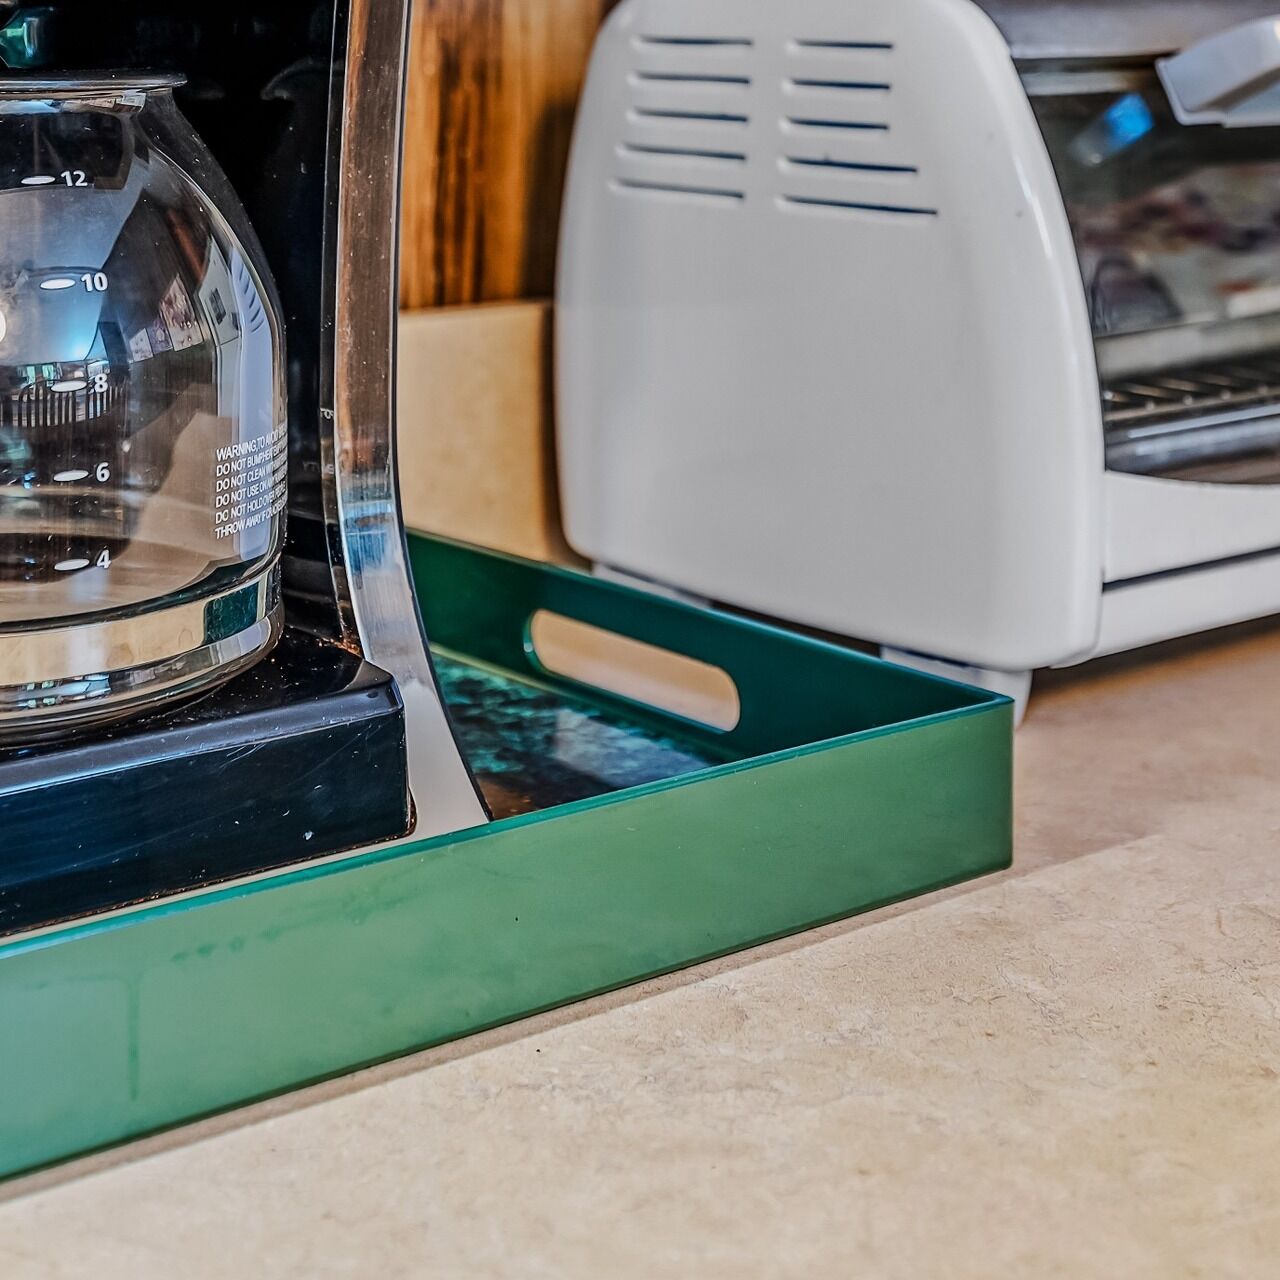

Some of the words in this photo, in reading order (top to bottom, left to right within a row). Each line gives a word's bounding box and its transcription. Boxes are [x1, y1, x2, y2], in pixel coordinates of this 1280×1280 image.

[60, 171, 88, 188] 12
[81, 273, 108, 292] 10
[94, 373, 109, 393] 8
[96, 462, 110, 482] 6
[216, 463, 230, 477] DO
[231, 458, 247, 472] NOT
[216, 478, 230, 492] DO
[231, 473, 247, 488] NOT
[215, 493, 230, 508] DO
[231, 488, 247, 504] NOT
[247, 483, 260, 497] USE
[215, 509, 229, 524] DO
[231, 503, 247, 519] NOT
[214, 519, 246, 539] THROW
[96, 551, 111, 570] 4
